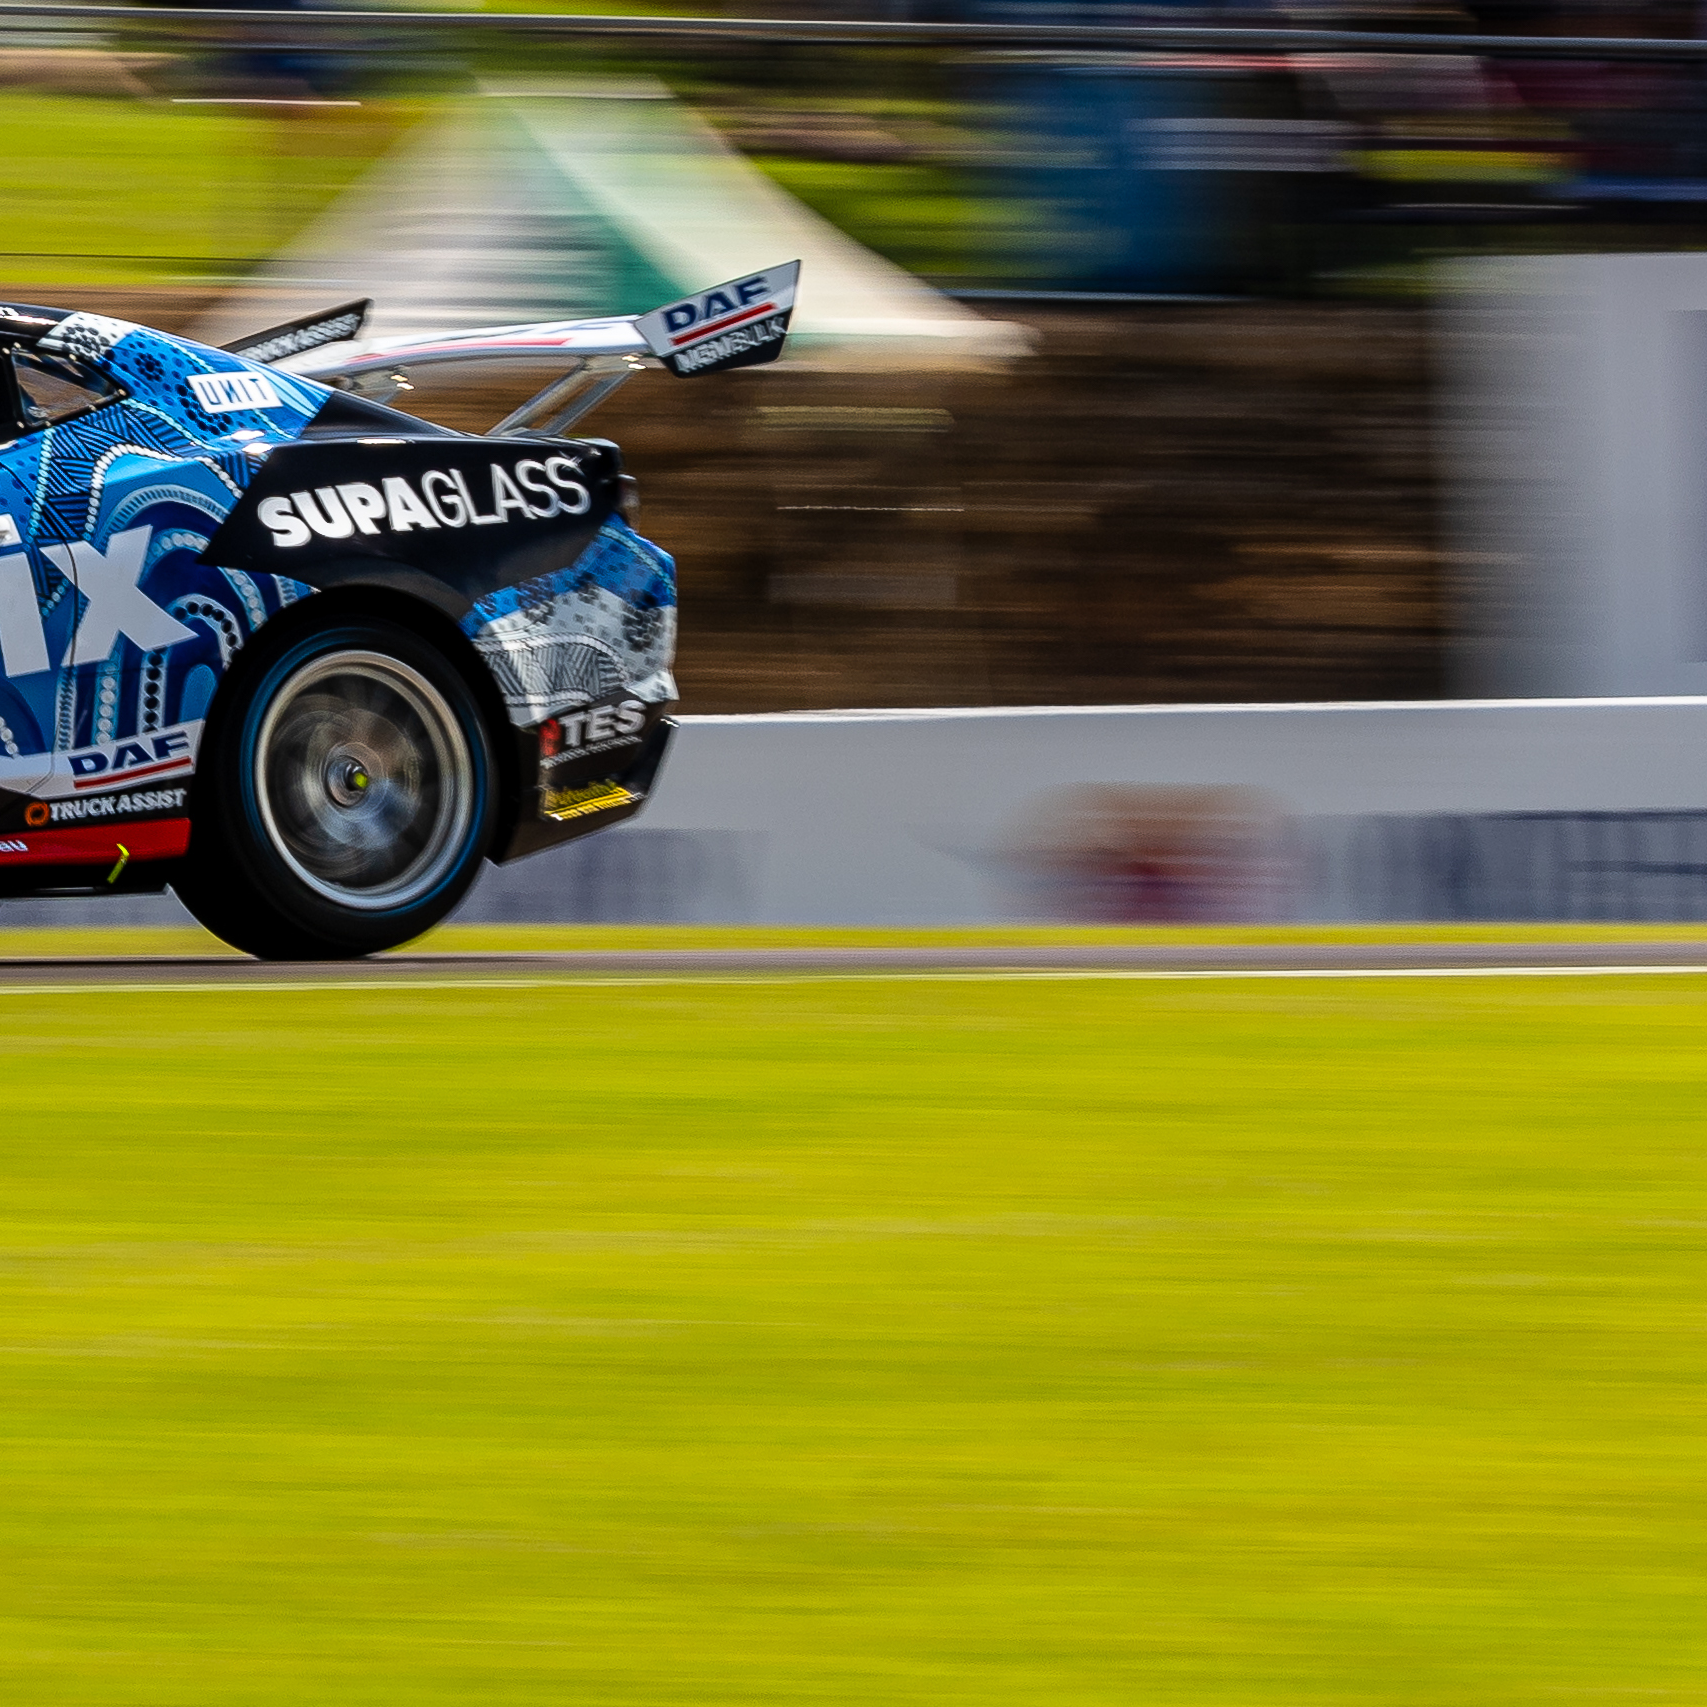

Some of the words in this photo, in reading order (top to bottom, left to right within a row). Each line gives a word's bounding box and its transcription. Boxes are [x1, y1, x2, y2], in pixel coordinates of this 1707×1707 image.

[663, 276, 771, 332] DAF
[197, 377, 268, 406] UNIT
[257, 456, 592, 548] SUPAGLASS
[558, 699, 648, 747] TES
[68, 730, 190, 776] DAF
[49, 794, 117, 822] TRUCK
[116, 787, 187, 814] ASSIST
